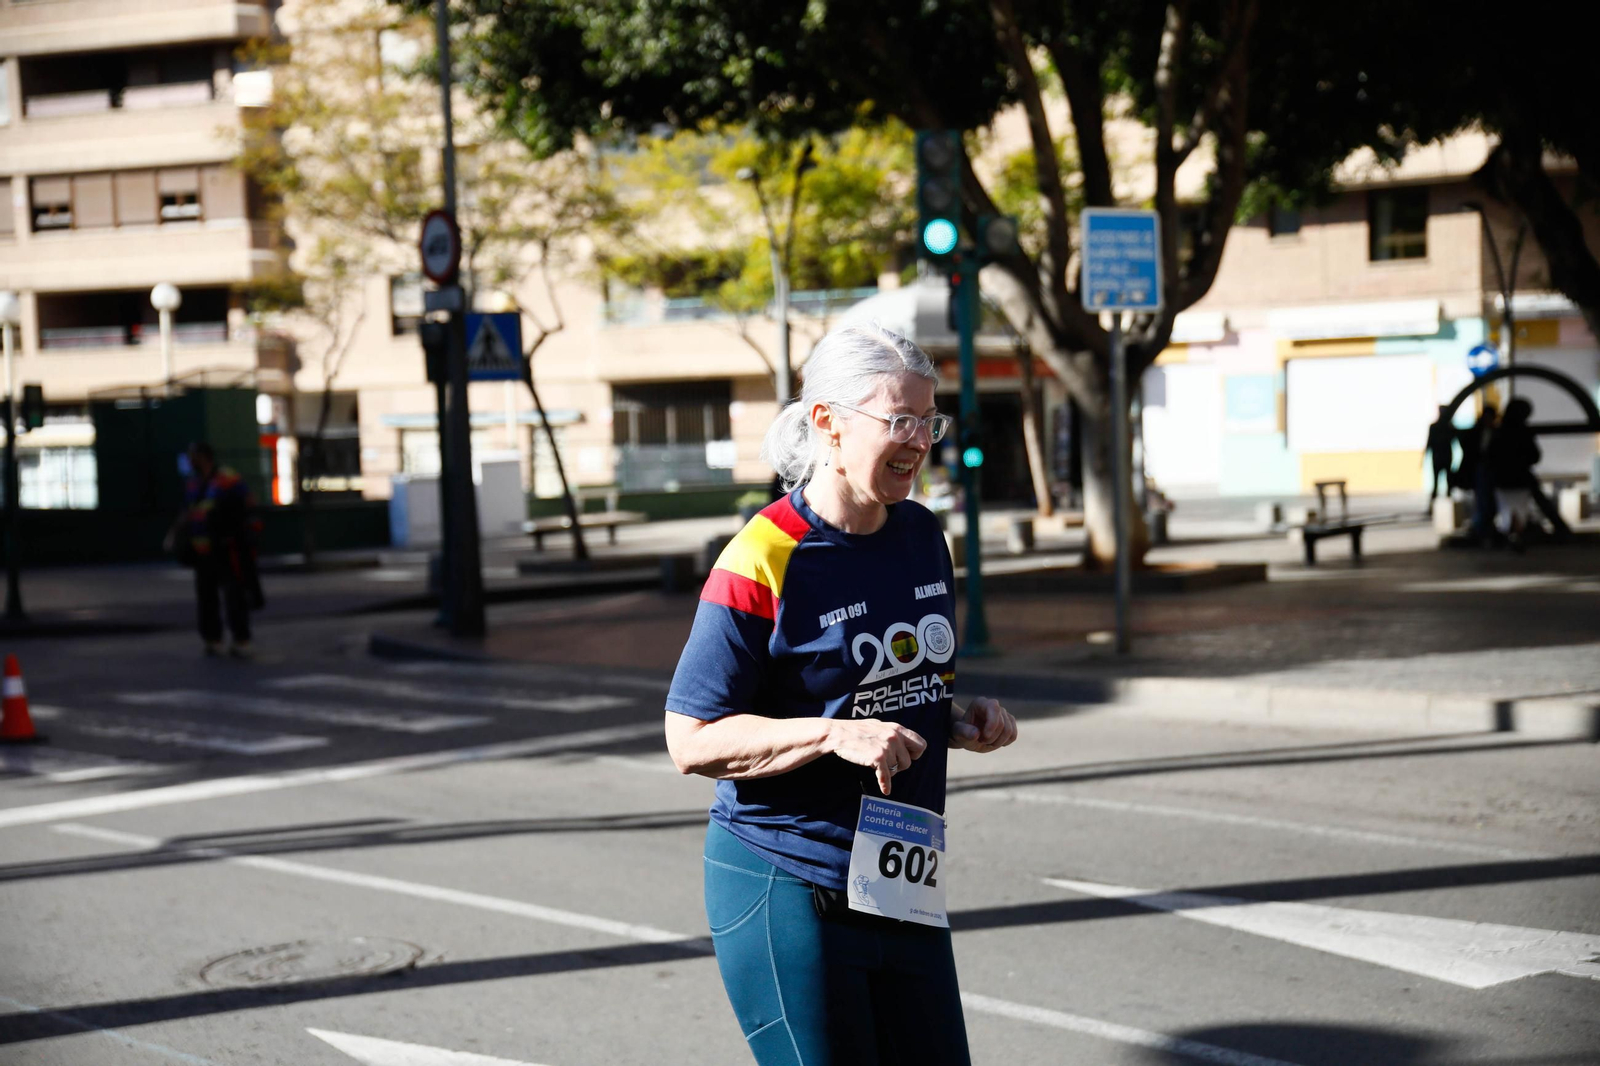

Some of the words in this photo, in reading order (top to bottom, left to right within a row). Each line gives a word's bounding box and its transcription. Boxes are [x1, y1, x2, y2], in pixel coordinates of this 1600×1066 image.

[914, 580, 947, 600] ALMERÍA
[819, 607, 848, 629] RUTA
[848, 601, 867, 618] 091
[852, 613, 955, 686] 200
[854, 673, 944, 704] POLICIA
[864, 815, 894, 827] contra
[895, 821, 904, 830] el
[905, 823, 929, 834] cáncer
[866, 803, 902, 818] Almería
[878, 840, 938, 888] 602
